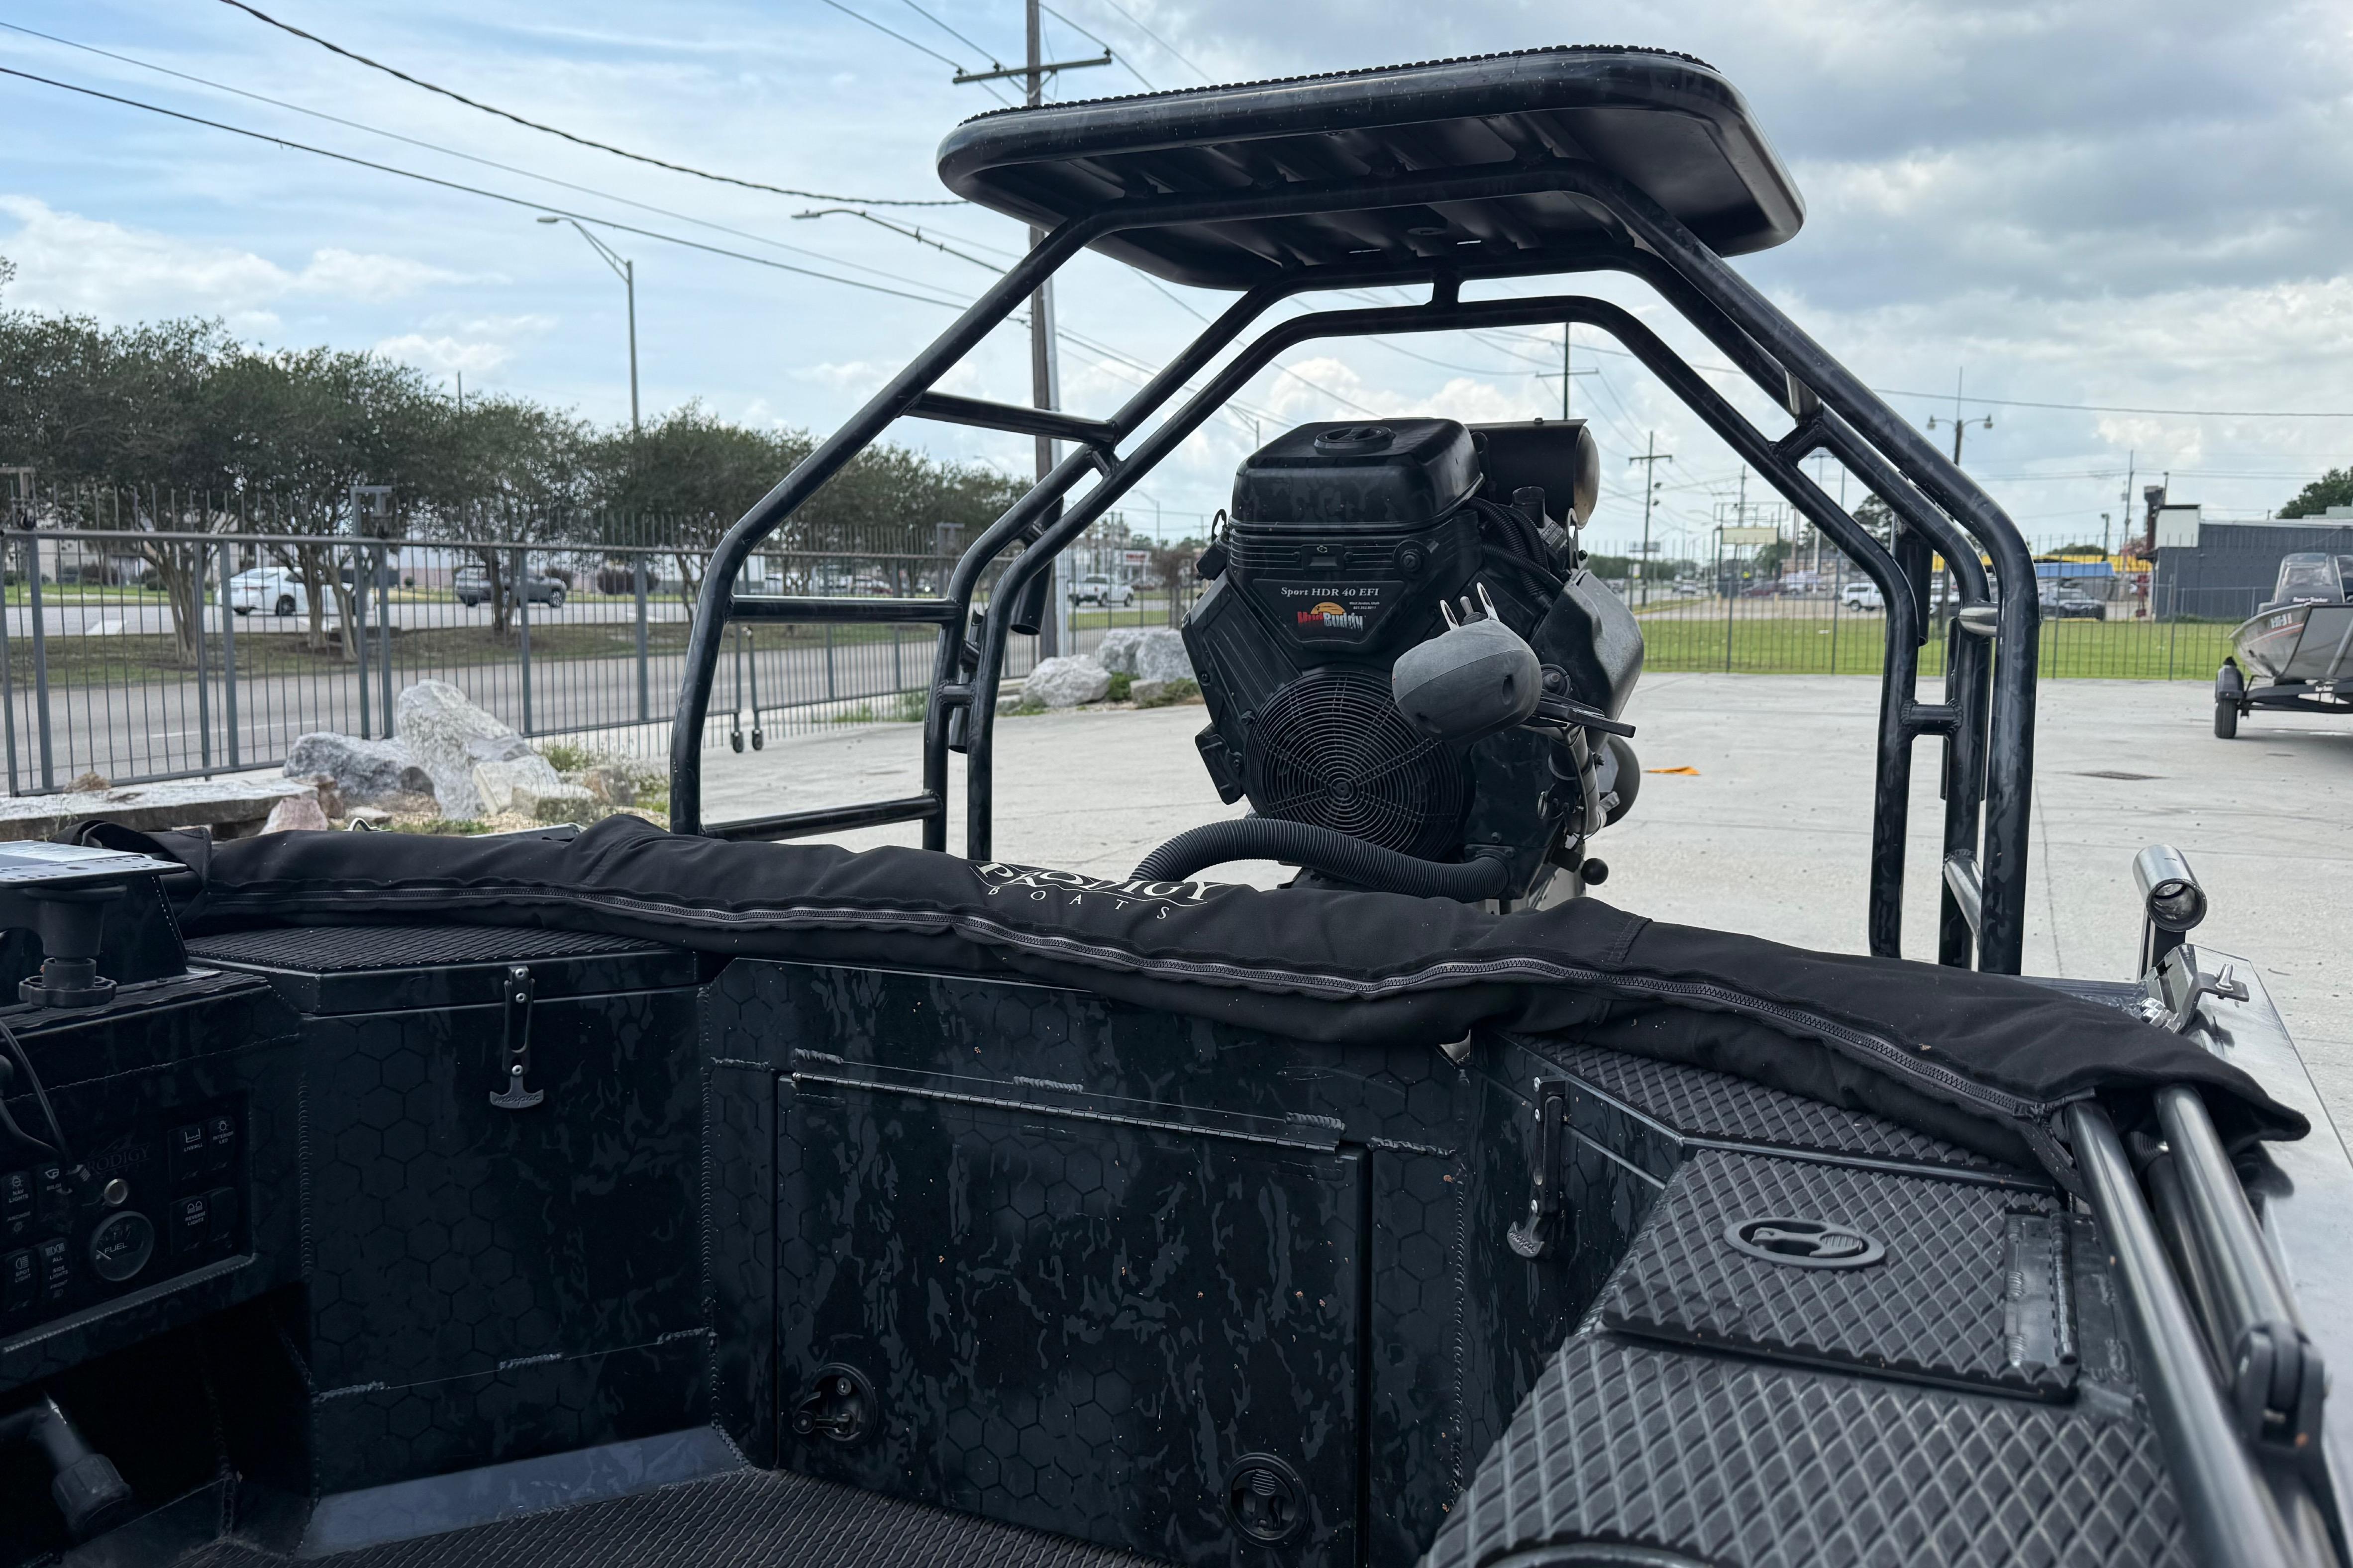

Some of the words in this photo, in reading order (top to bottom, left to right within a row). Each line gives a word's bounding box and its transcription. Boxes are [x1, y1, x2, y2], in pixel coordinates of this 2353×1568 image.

[1281, 587, 1309, 597] Sport
[976, 863, 1231, 900] PRODIGY
[988, 887, 1170, 919] BOATS
[84, 1144, 152, 1175] RODIGY
[104, 1242, 128, 1254] FUEL
